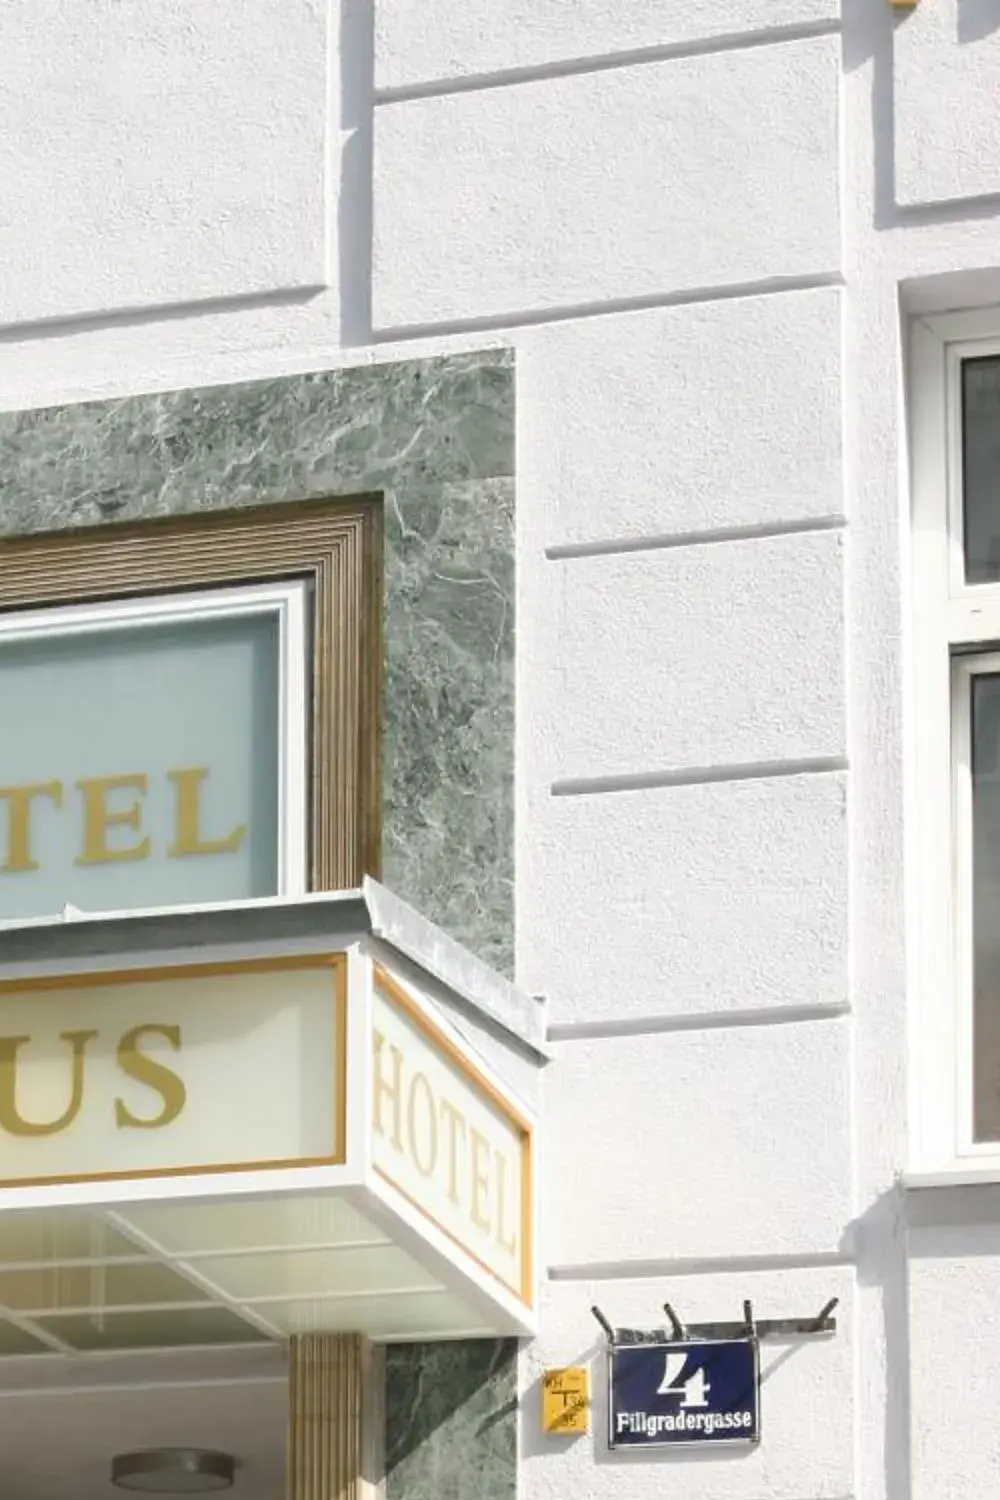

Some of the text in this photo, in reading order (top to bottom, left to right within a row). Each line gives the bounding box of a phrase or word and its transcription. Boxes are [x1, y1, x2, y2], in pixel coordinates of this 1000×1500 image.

[372, 1027, 517, 1257] HOTEL
[656, 1352, 711, 1407] 4
[616, 1409, 752, 1437] Fillgradergasse
